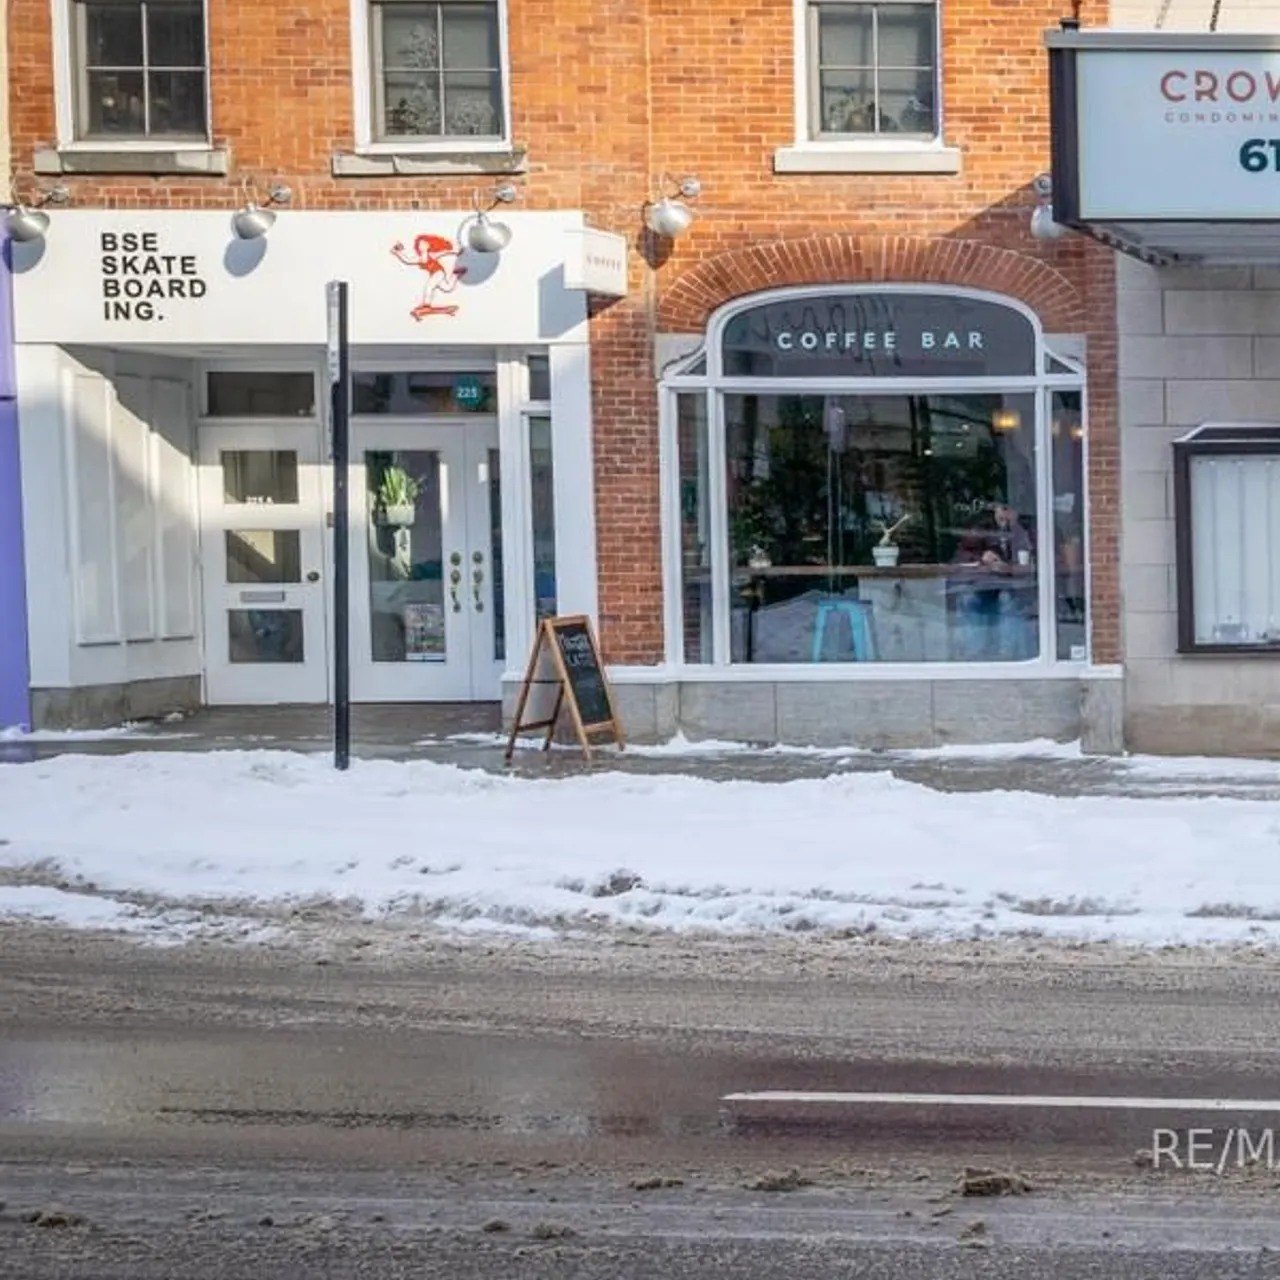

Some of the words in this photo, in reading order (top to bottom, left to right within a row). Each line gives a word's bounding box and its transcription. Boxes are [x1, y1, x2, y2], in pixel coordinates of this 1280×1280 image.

[101, 232, 158, 252] BSE
[101, 255, 197, 275] SKATE
[103, 278, 206, 298] BOARD
[104, 301, 164, 321] ING.
[777, 332, 896, 349] COFFEE
[921, 332, 984, 349] BAR
